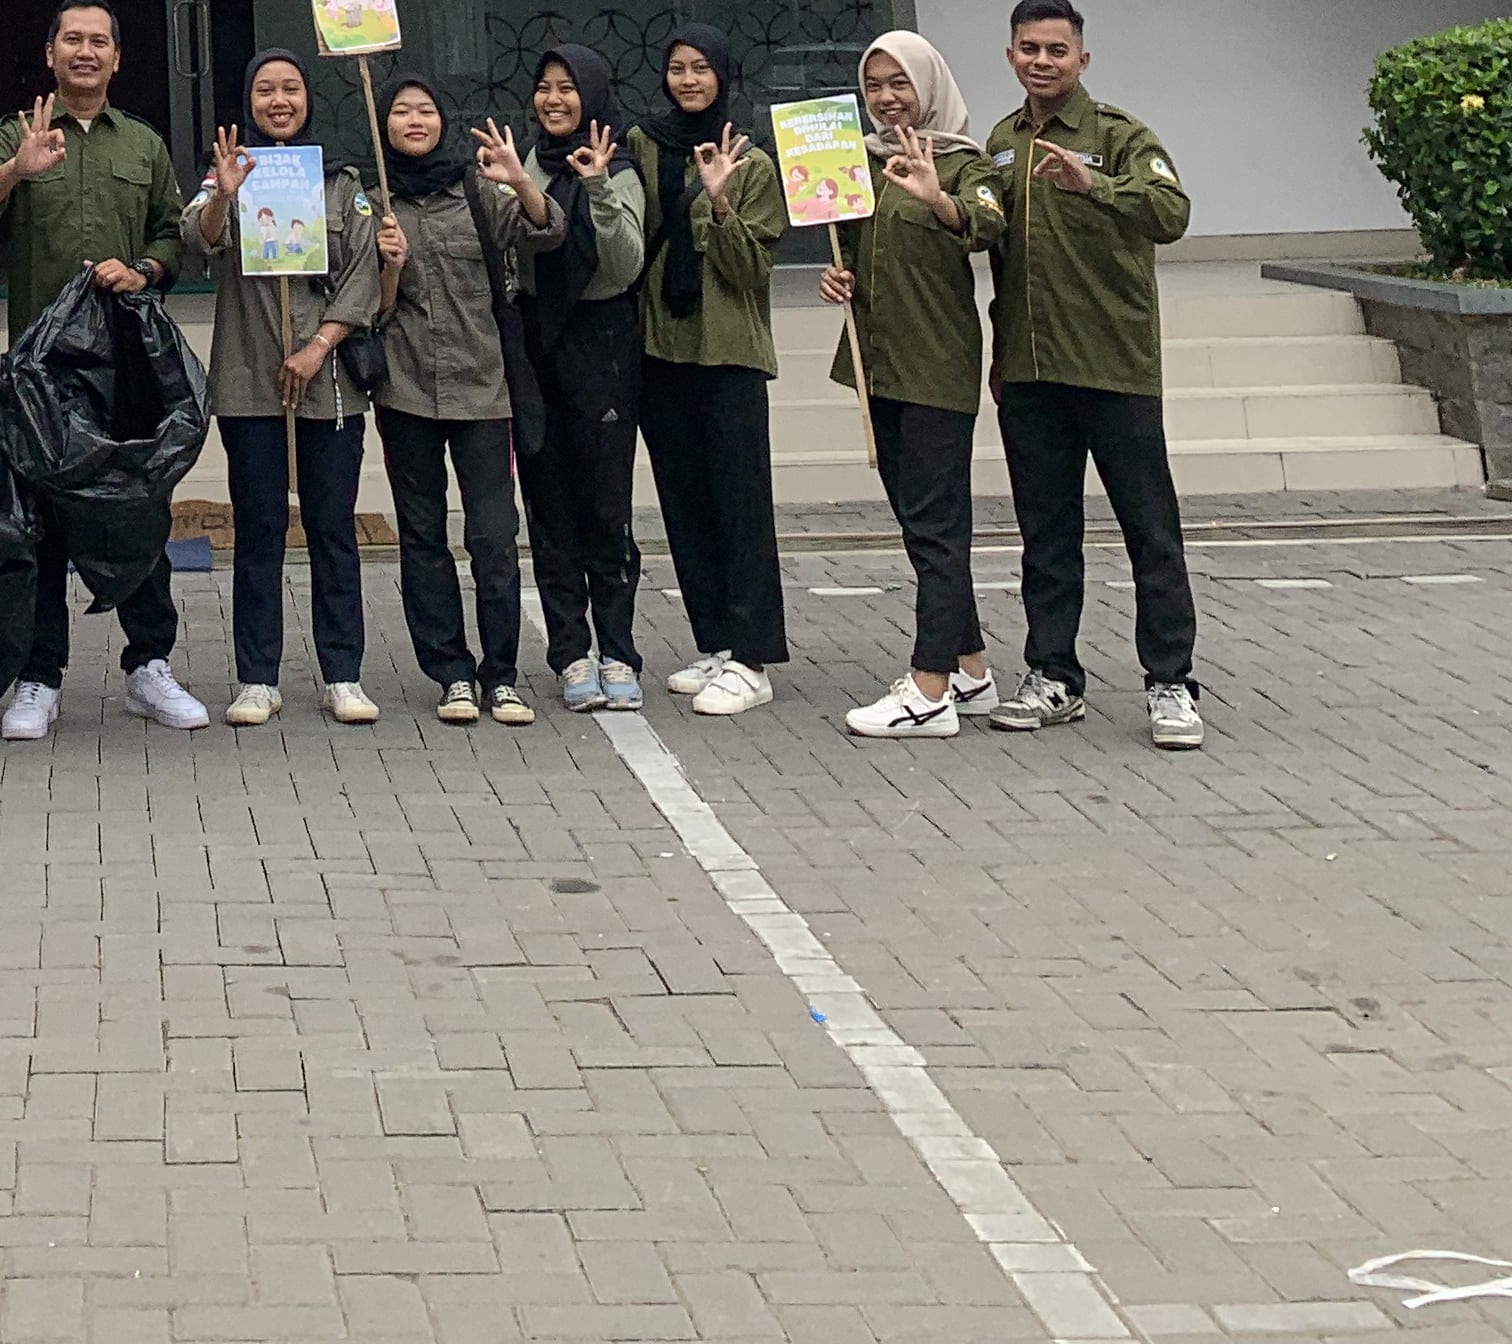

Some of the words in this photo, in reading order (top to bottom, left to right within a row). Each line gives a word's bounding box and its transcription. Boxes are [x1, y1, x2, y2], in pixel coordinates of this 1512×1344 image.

[779, 112, 854, 129] KEBERSIHAN
[793, 121, 843, 136] DIMULAI
[805, 131, 834, 143] DARI
[785, 140, 857, 158] KESADARAN
[258, 153, 302, 167] BIJAK
[253, 166, 306, 179] KELOLA
[251, 178, 310, 192] SAMPAH
